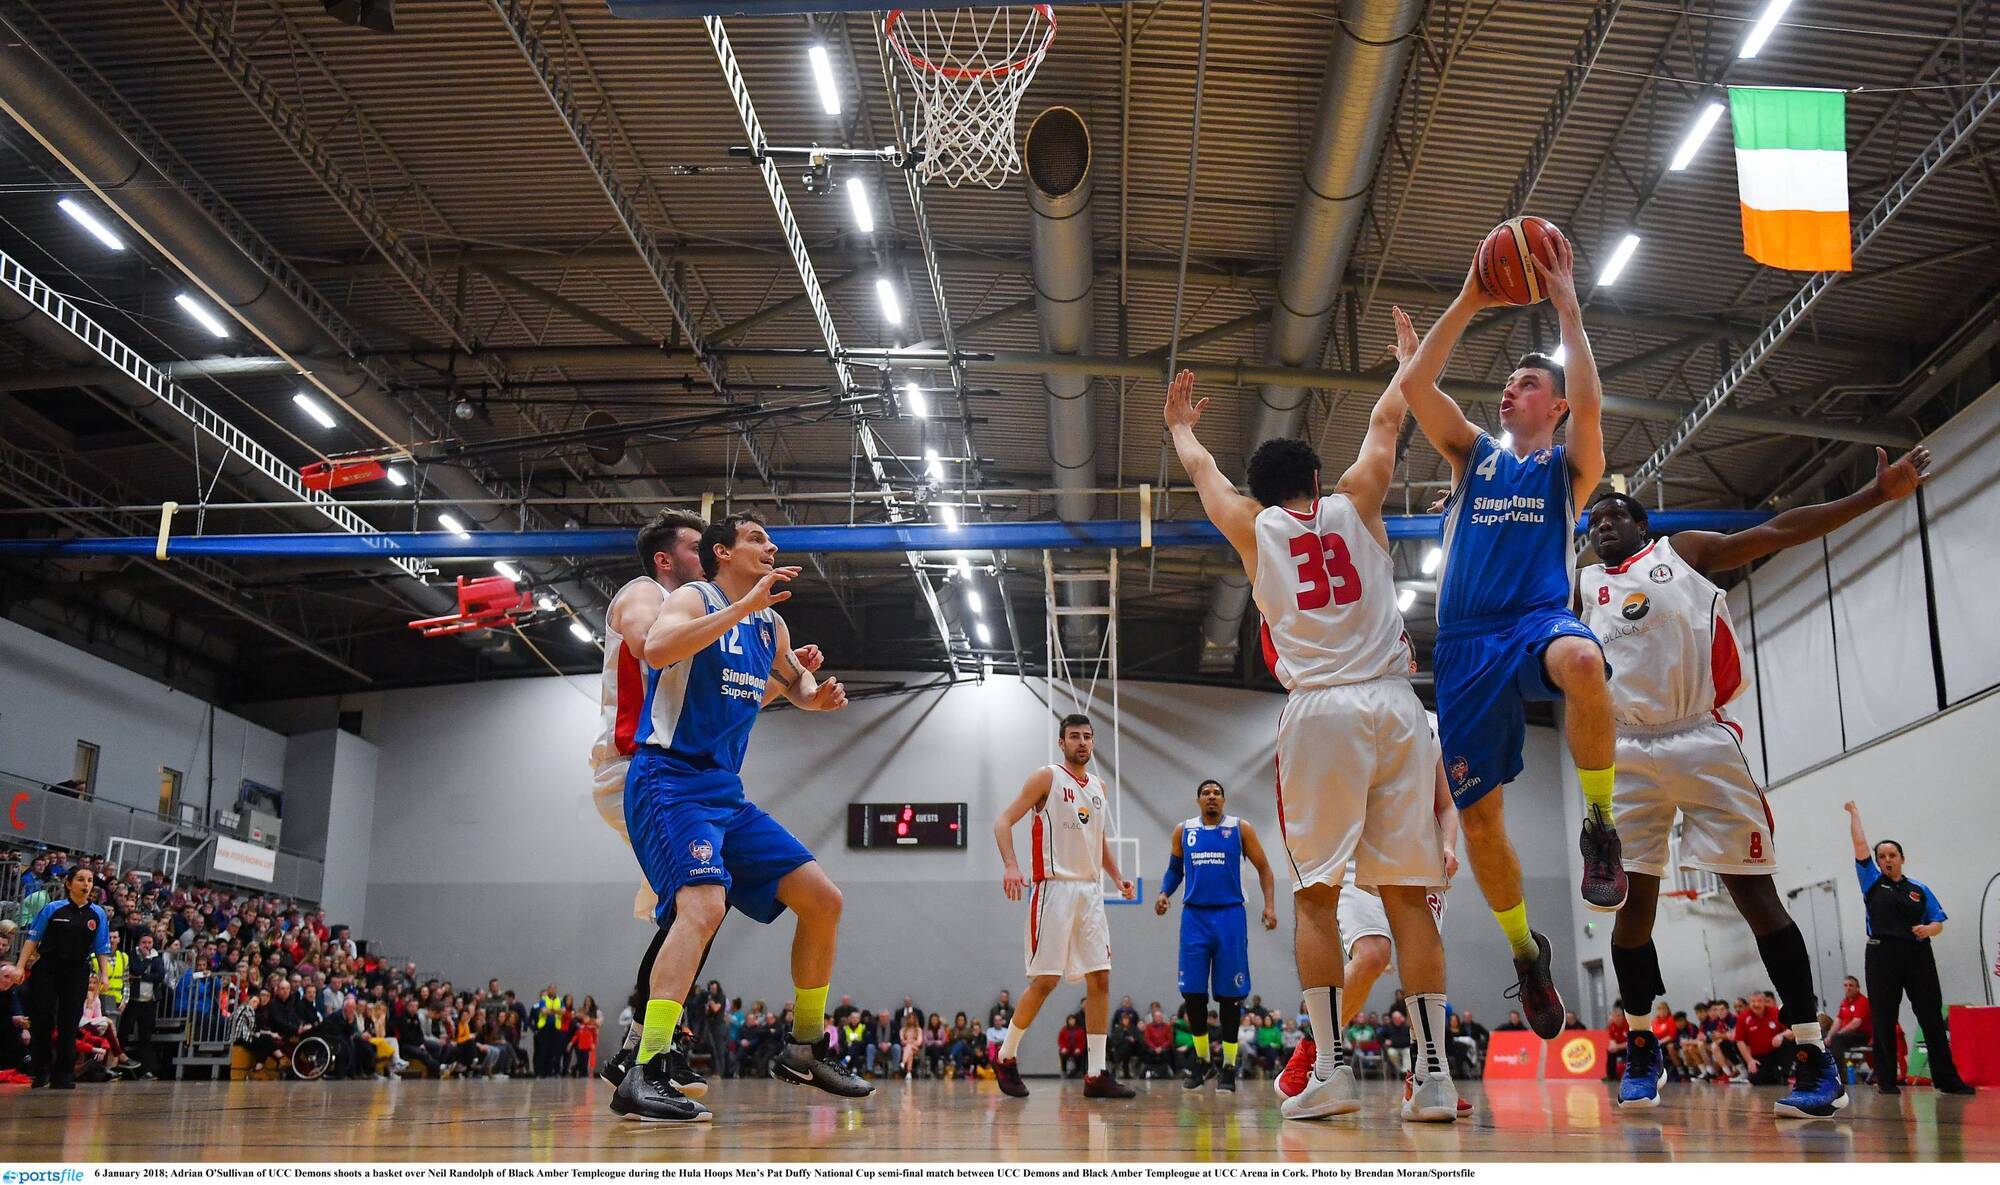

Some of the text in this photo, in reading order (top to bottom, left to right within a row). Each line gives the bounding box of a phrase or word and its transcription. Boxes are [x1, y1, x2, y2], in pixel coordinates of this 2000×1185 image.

[1476, 449, 1501, 481] 4
[1471, 511, 1544, 526] SuperValu
[1288, 532, 1363, 611] 33
[1598, 586, 1610, 605] 8
[1063, 787, 1075, 804] 14
[9, 792, 30, 830] C
[916, 814, 939, 823] GUESTS
[1187, 830, 1197, 847] 6
[1750, 831, 1763, 858] 8
